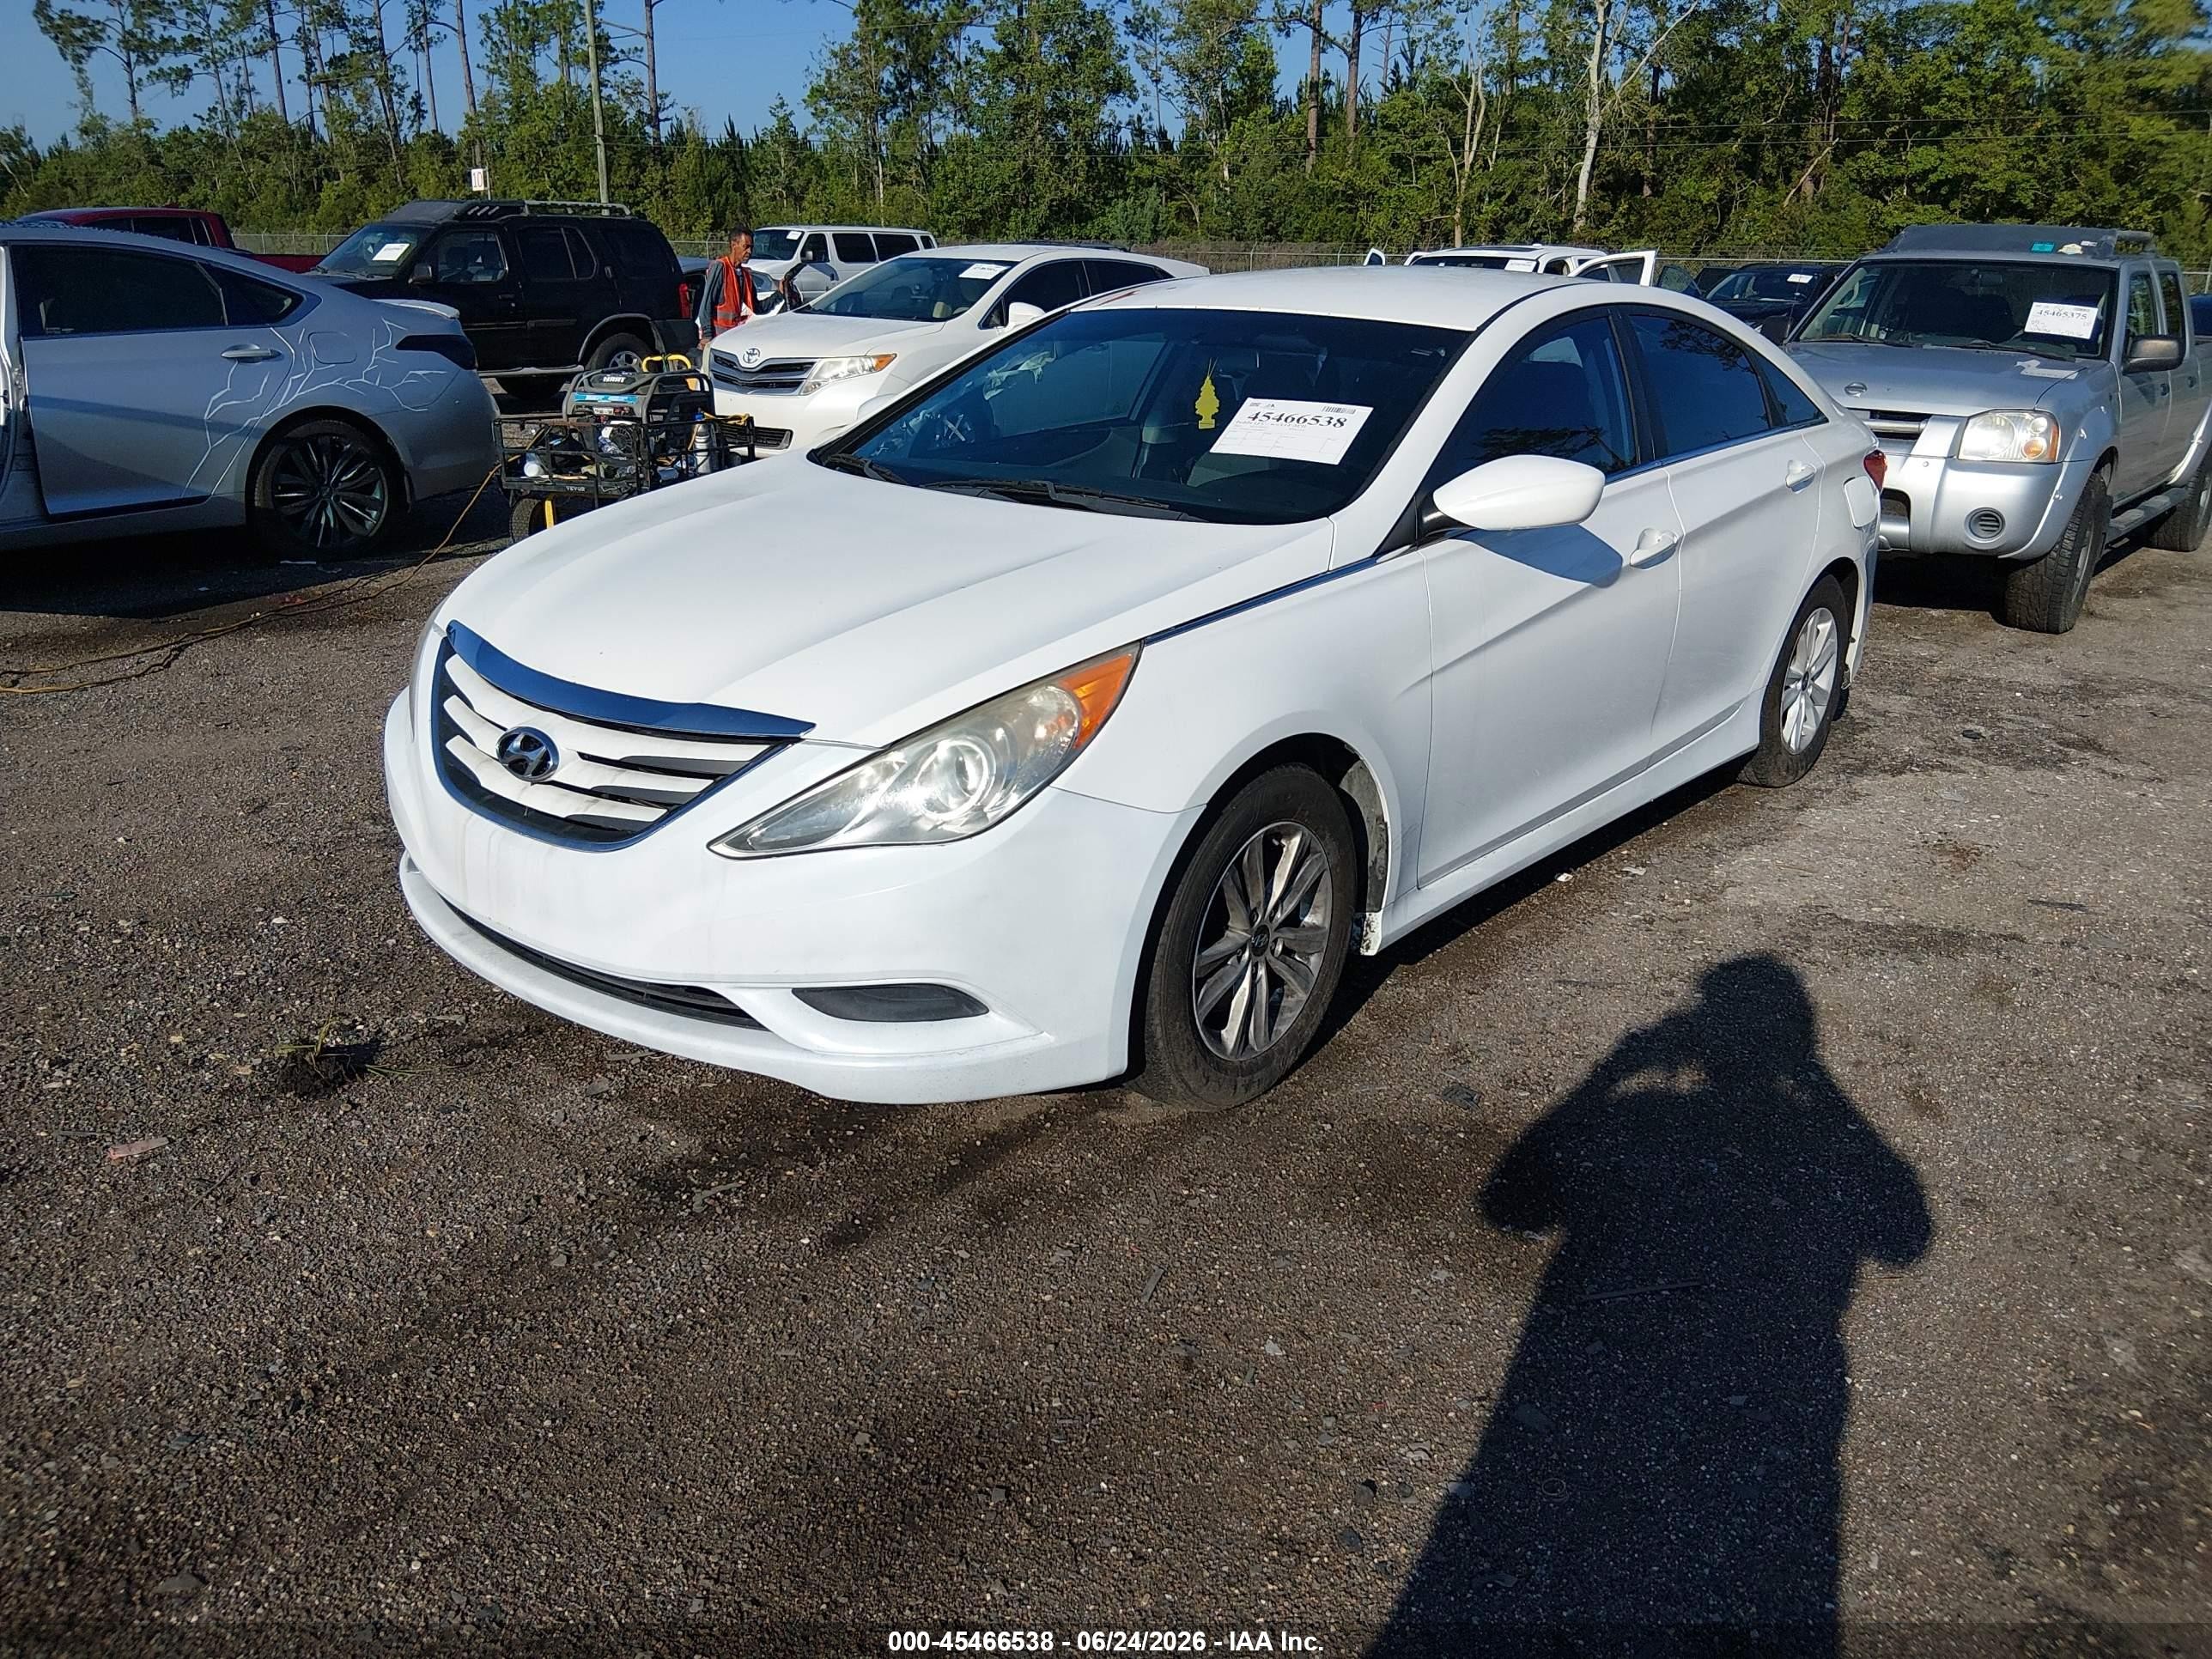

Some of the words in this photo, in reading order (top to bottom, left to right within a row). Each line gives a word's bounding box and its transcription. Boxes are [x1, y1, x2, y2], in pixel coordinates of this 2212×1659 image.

[473, 172, 483, 187] 10
[2037, 310, 2087, 320] 45465375
[1248, 411, 1347, 428] 45466538
